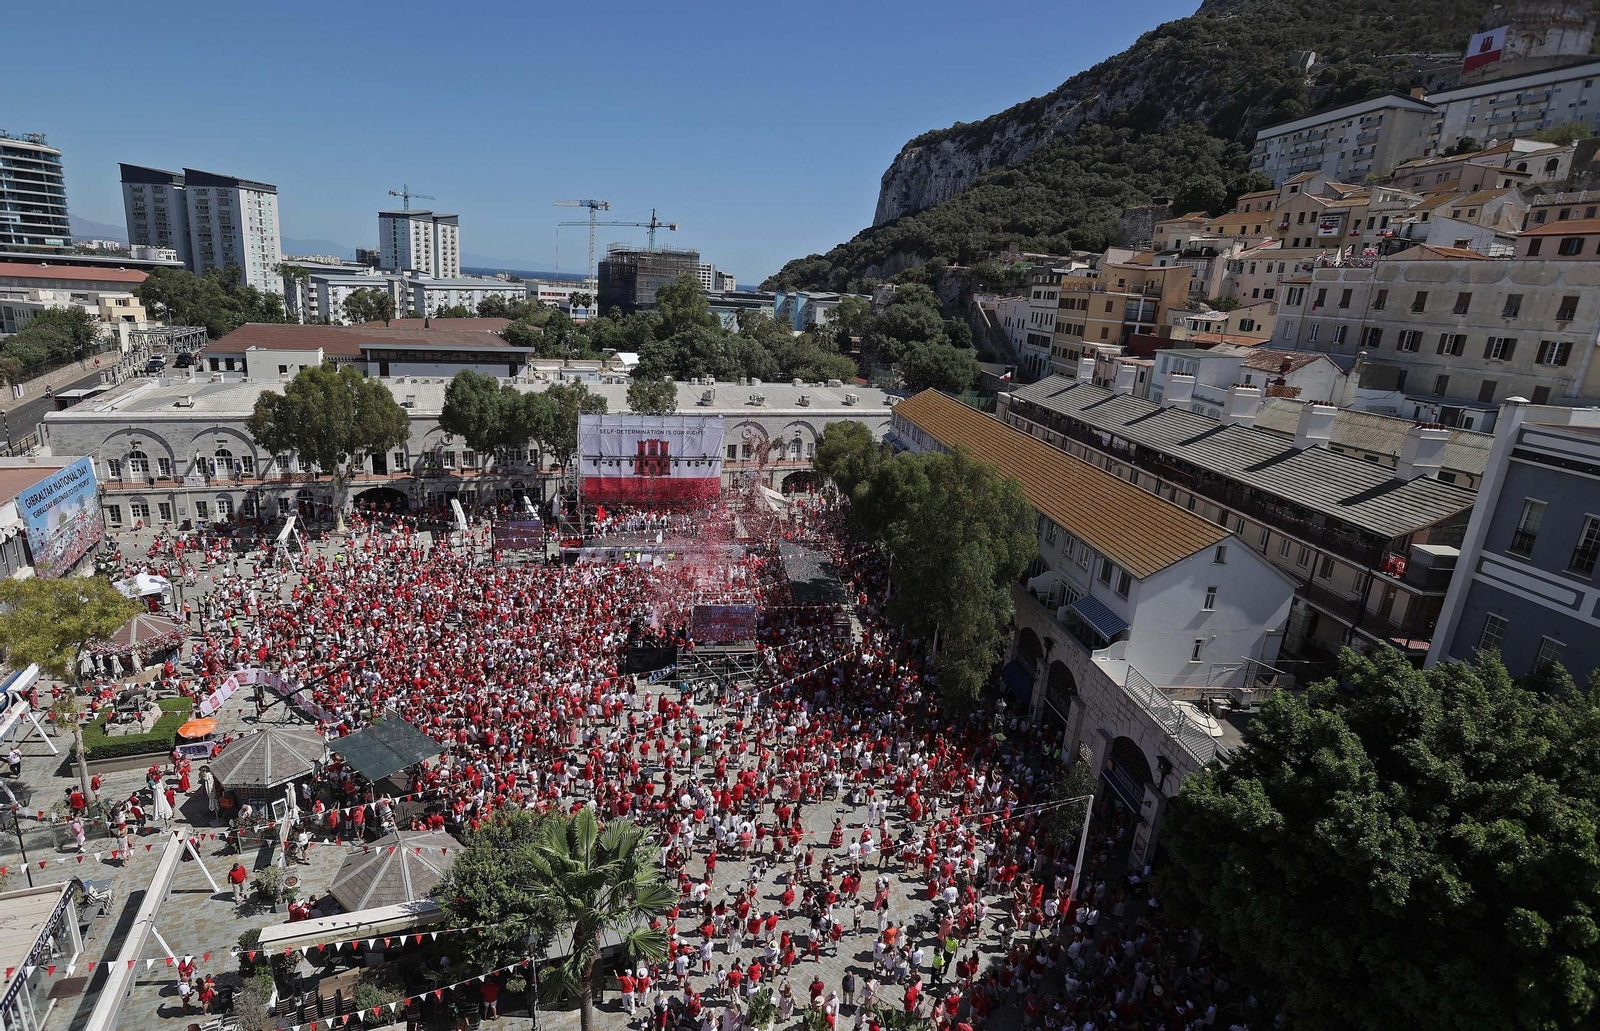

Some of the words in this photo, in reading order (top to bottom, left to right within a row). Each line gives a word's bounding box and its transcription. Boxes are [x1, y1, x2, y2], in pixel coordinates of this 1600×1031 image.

[25, 484, 54, 508] GIBRALTAR
[53, 471, 79, 490] NATIONAL
[77, 464, 88, 478] DAY
[52, 491, 68, 506] BELONGS
